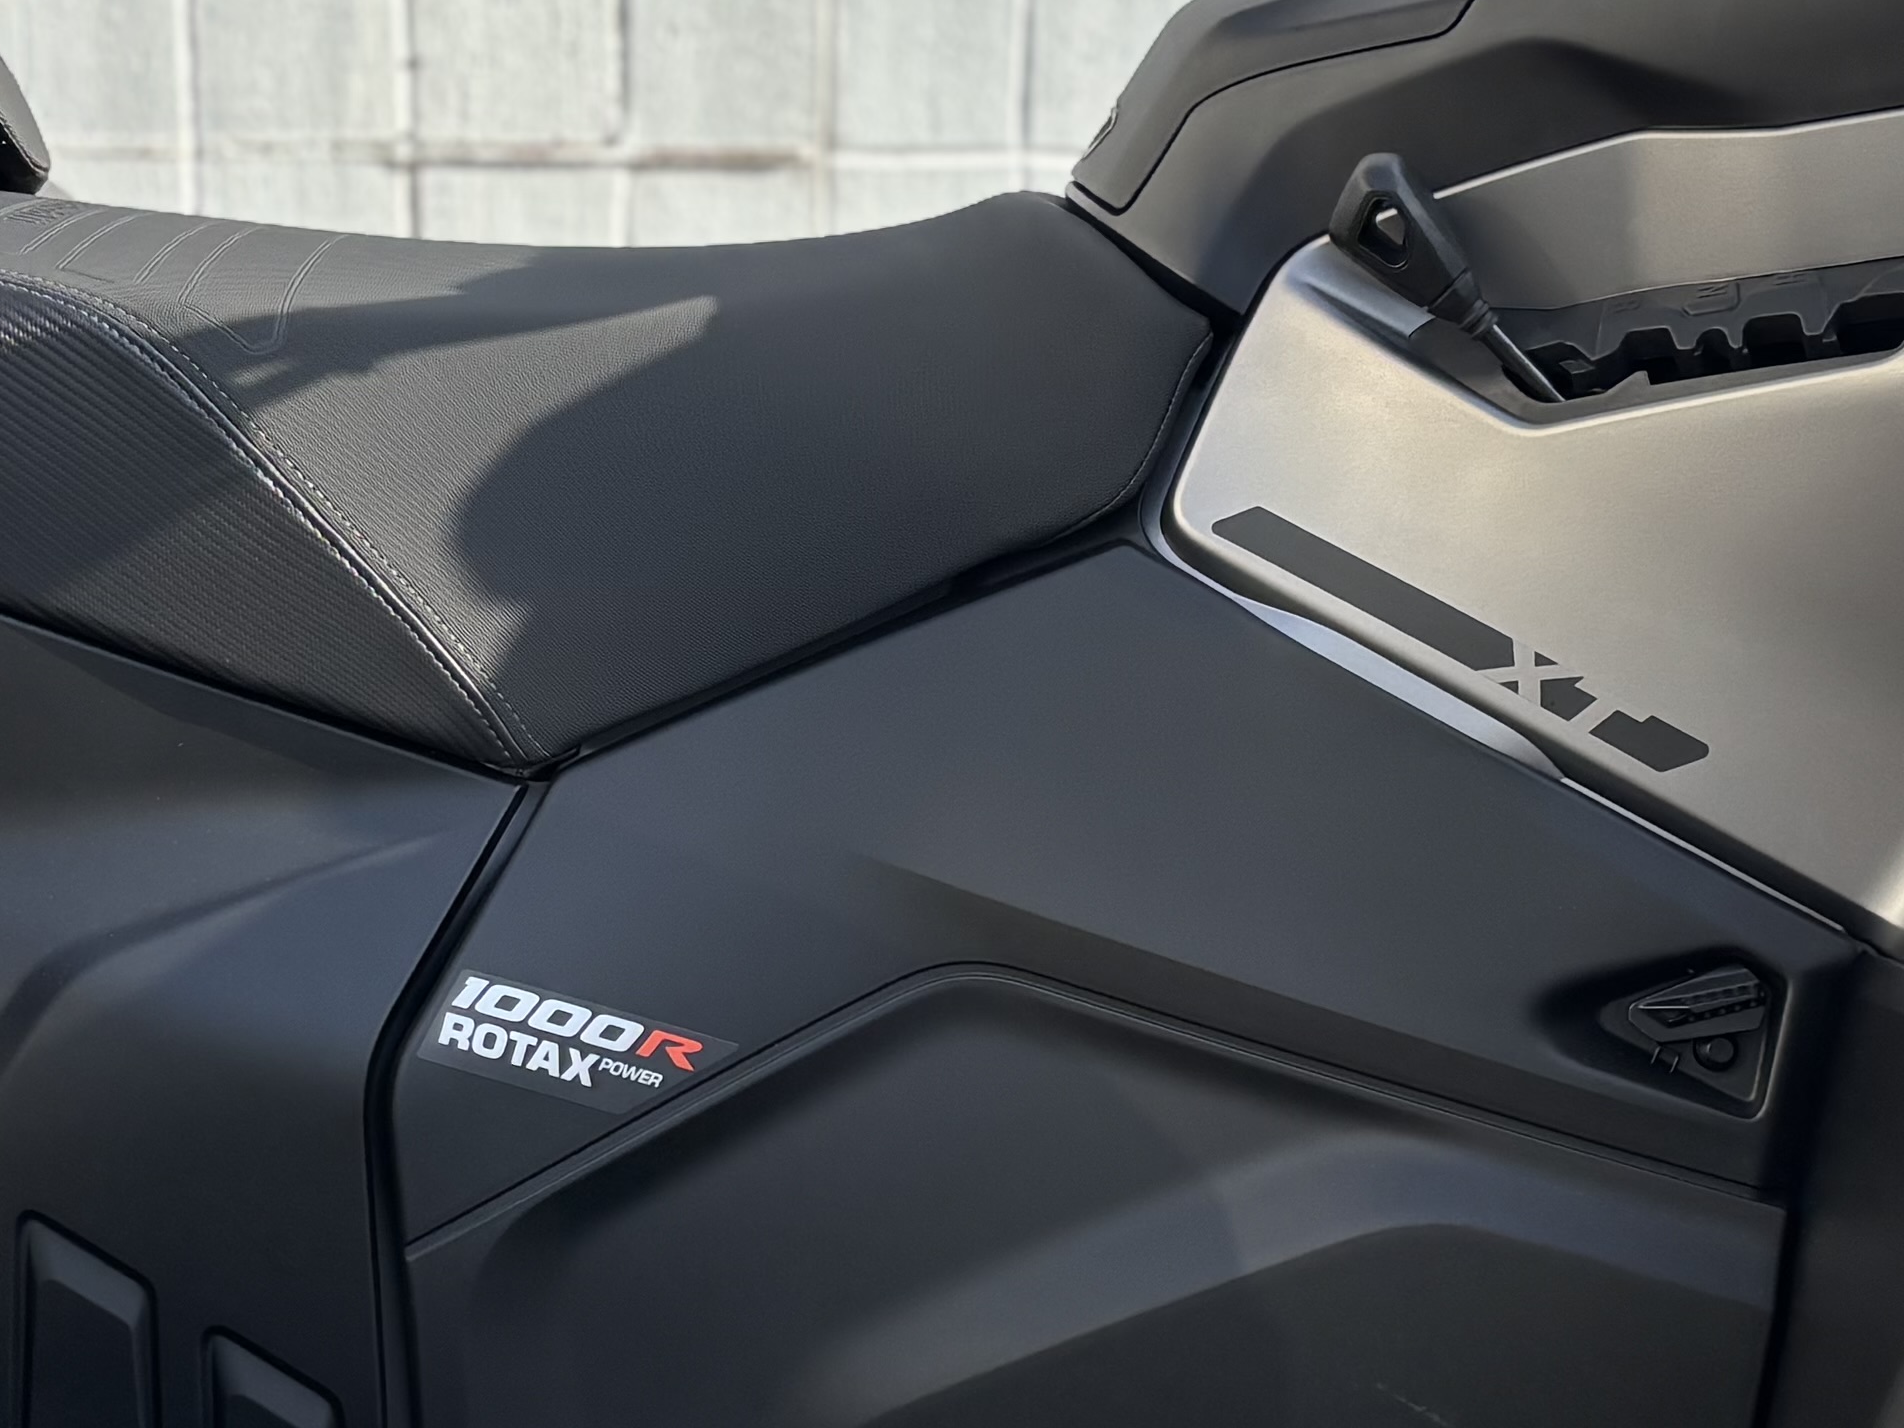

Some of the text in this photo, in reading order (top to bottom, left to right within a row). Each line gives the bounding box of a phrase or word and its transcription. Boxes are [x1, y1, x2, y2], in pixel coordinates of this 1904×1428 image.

[437, 1011, 664, 1089] ROTAX POWER
[451, 975, 704, 1072] 1000R
